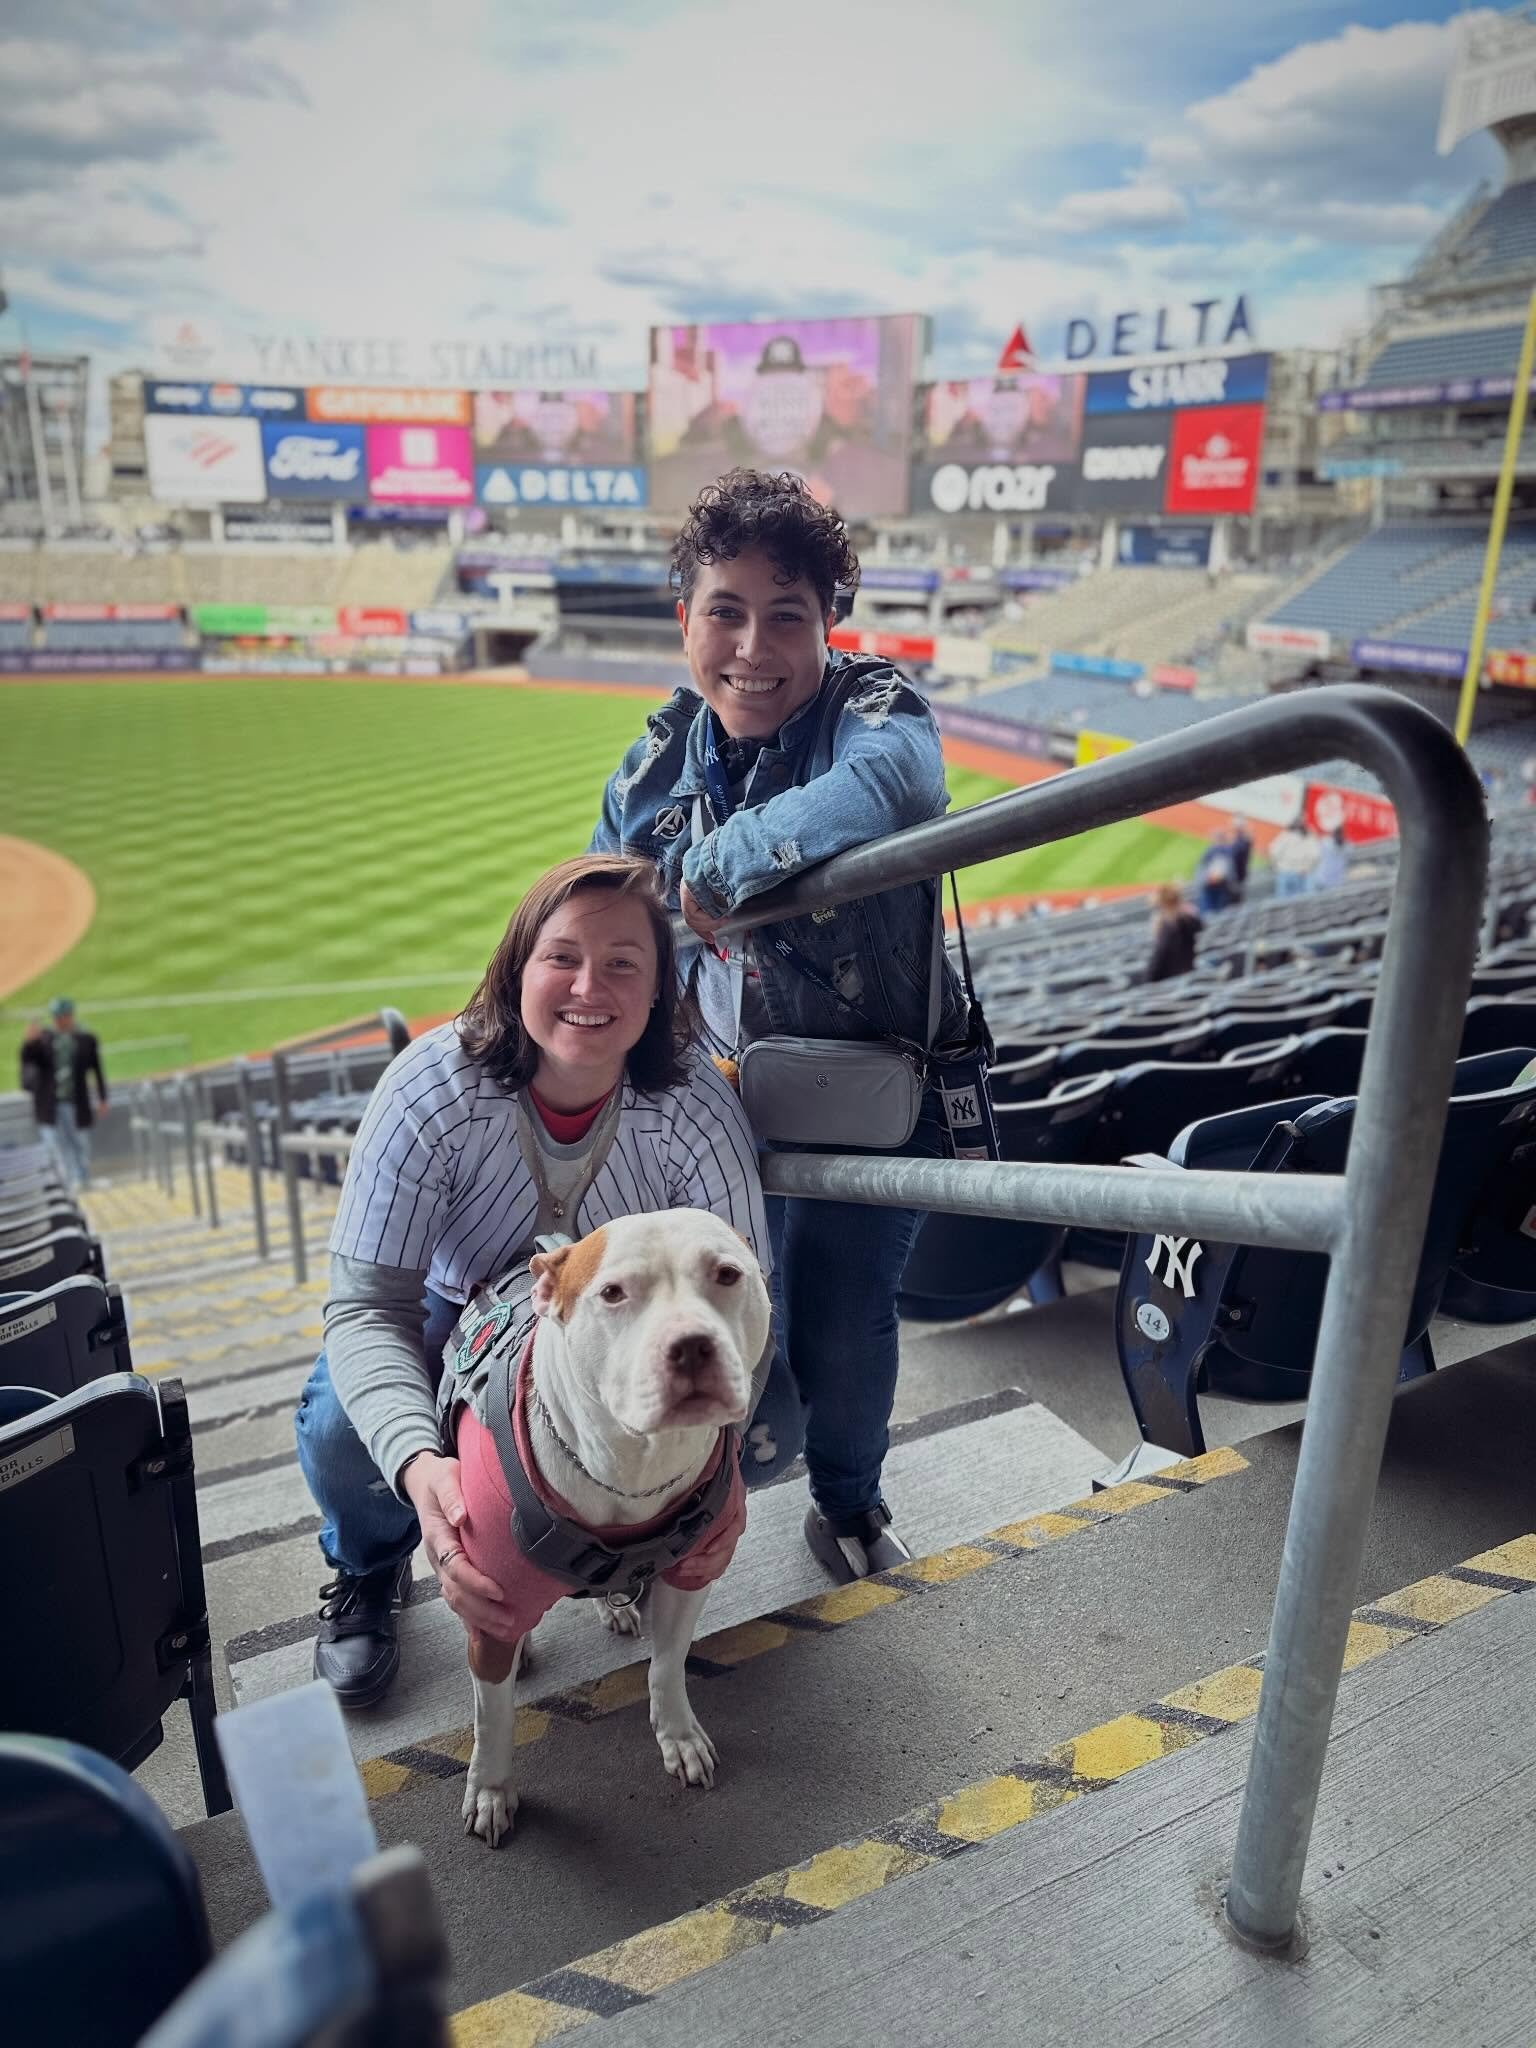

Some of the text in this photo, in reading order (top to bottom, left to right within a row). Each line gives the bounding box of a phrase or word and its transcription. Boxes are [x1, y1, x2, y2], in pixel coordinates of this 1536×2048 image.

[1066, 295, 1254, 360] DELTA
[251, 338, 409, 378] YANKEE
[269, 436, 360, 481] Ford
[519, 469, 640, 502] DELTA
[951, 1096, 976, 1120] NY
[1144, 1233, 1203, 1298] NY
[13, 1320, 39, 1336] BALLS
[1145, 1313, 1162, 1333] 14
[1, 1456, 44, 1483] BALLS
